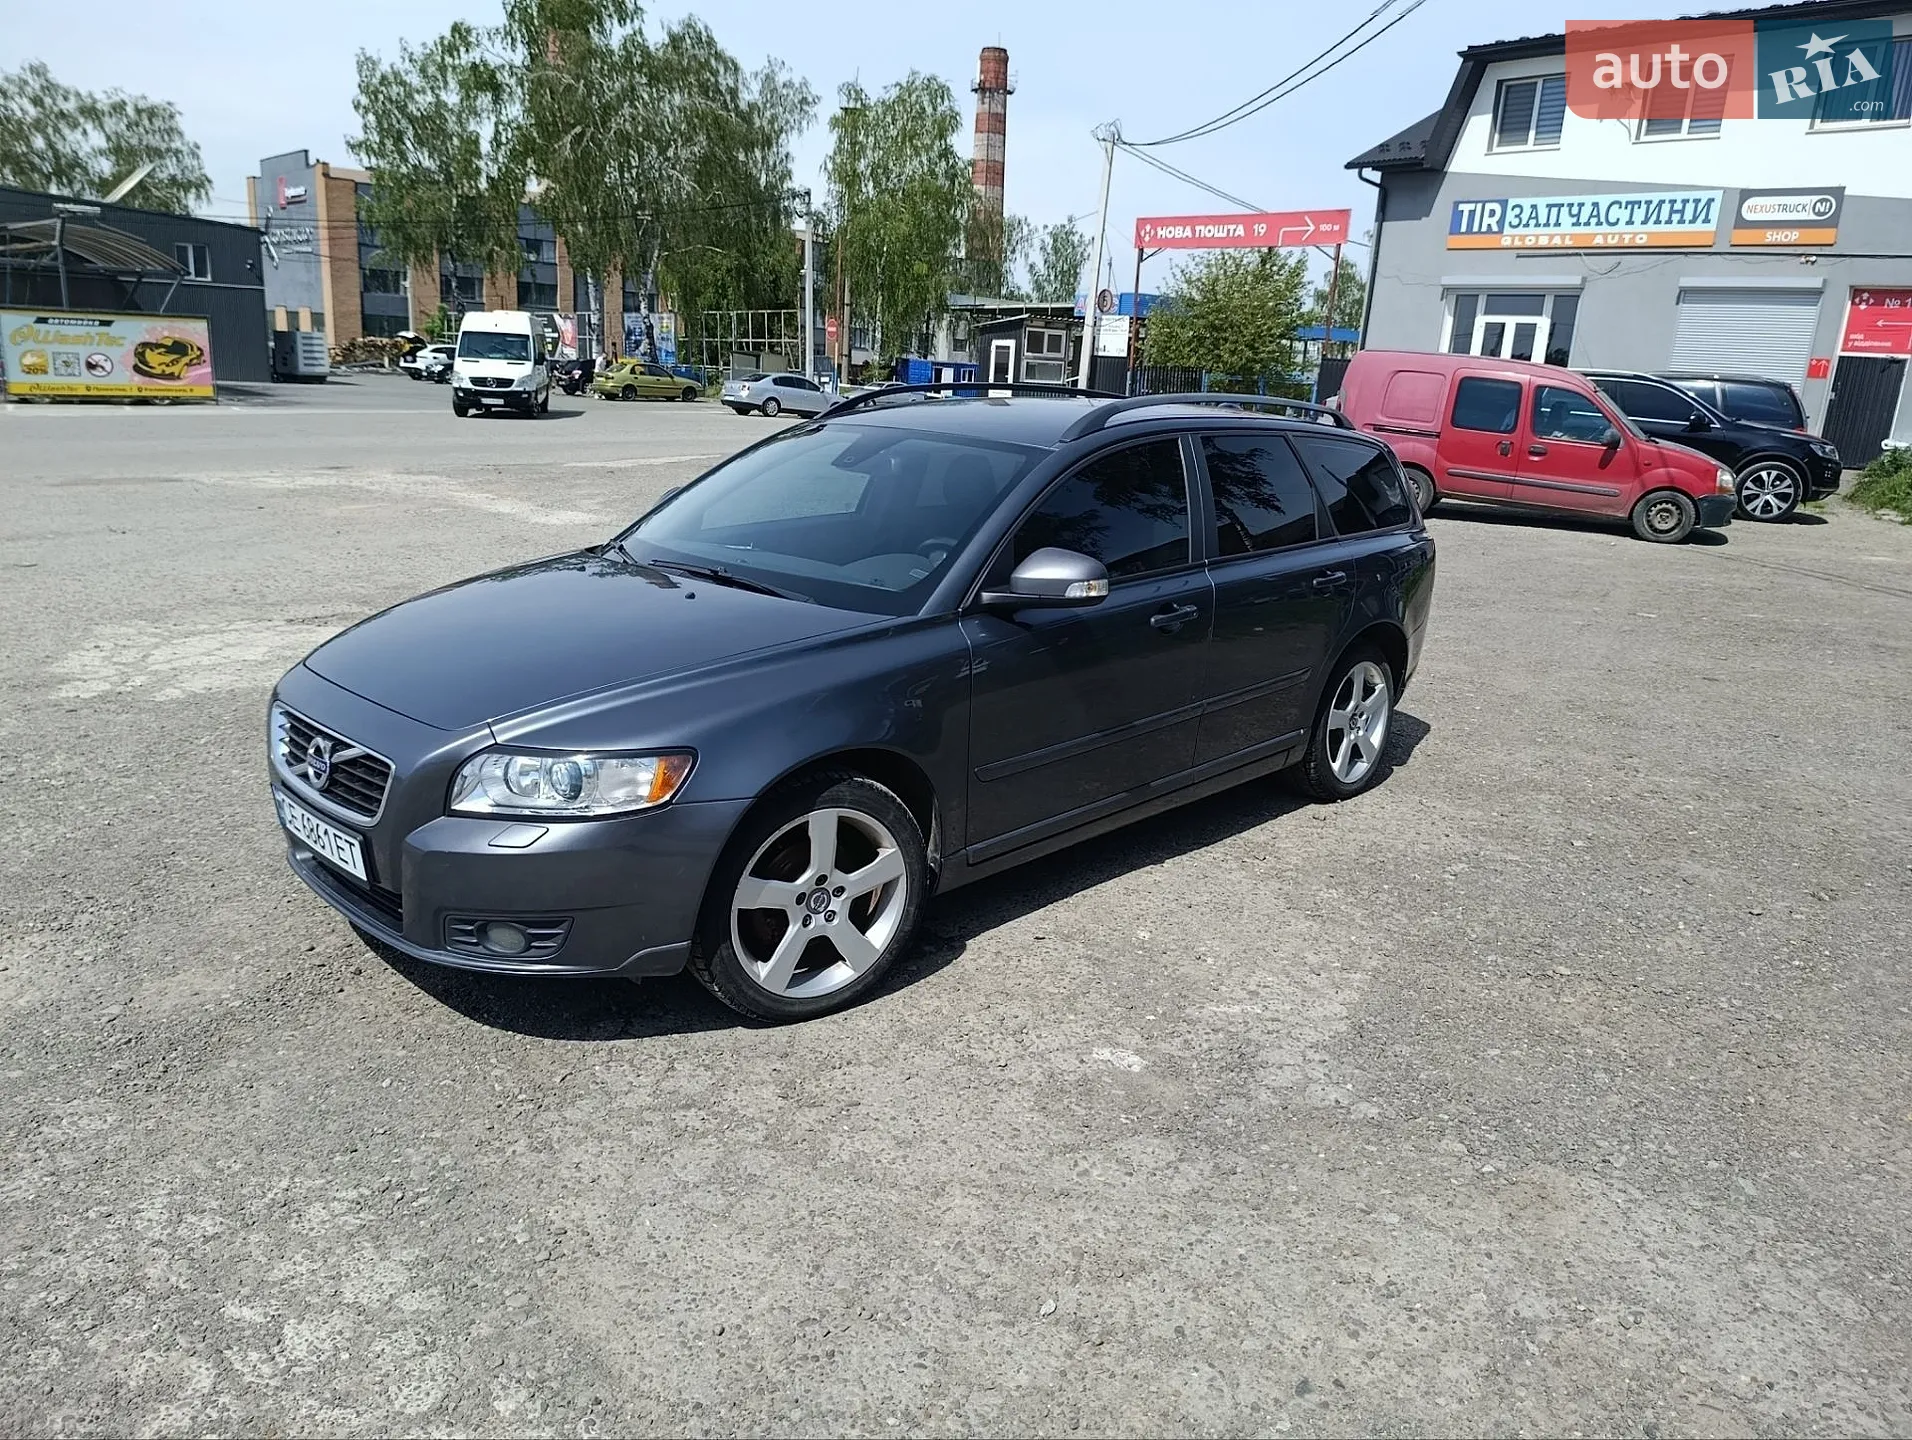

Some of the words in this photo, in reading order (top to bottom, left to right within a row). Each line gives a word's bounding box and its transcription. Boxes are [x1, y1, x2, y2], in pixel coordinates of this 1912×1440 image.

[1458, 202, 1502, 233] TIR
[1508, 197, 1715, 229] ЗАПЧАСТИНИ
[1746, 203, 1809, 214] NEXUSTRUCK
[1156, 225, 1192, 239] НОВА
[1195, 223, 1245, 238] ПОШТА
[1253, 223, 1267, 237] 19
[1765, 231, 1799, 242] SHOP
[1500, 235, 1574, 246] GLOBAL
[1592, 233, 1648, 244] AUTO
[333, 832, 357, 870] ET
